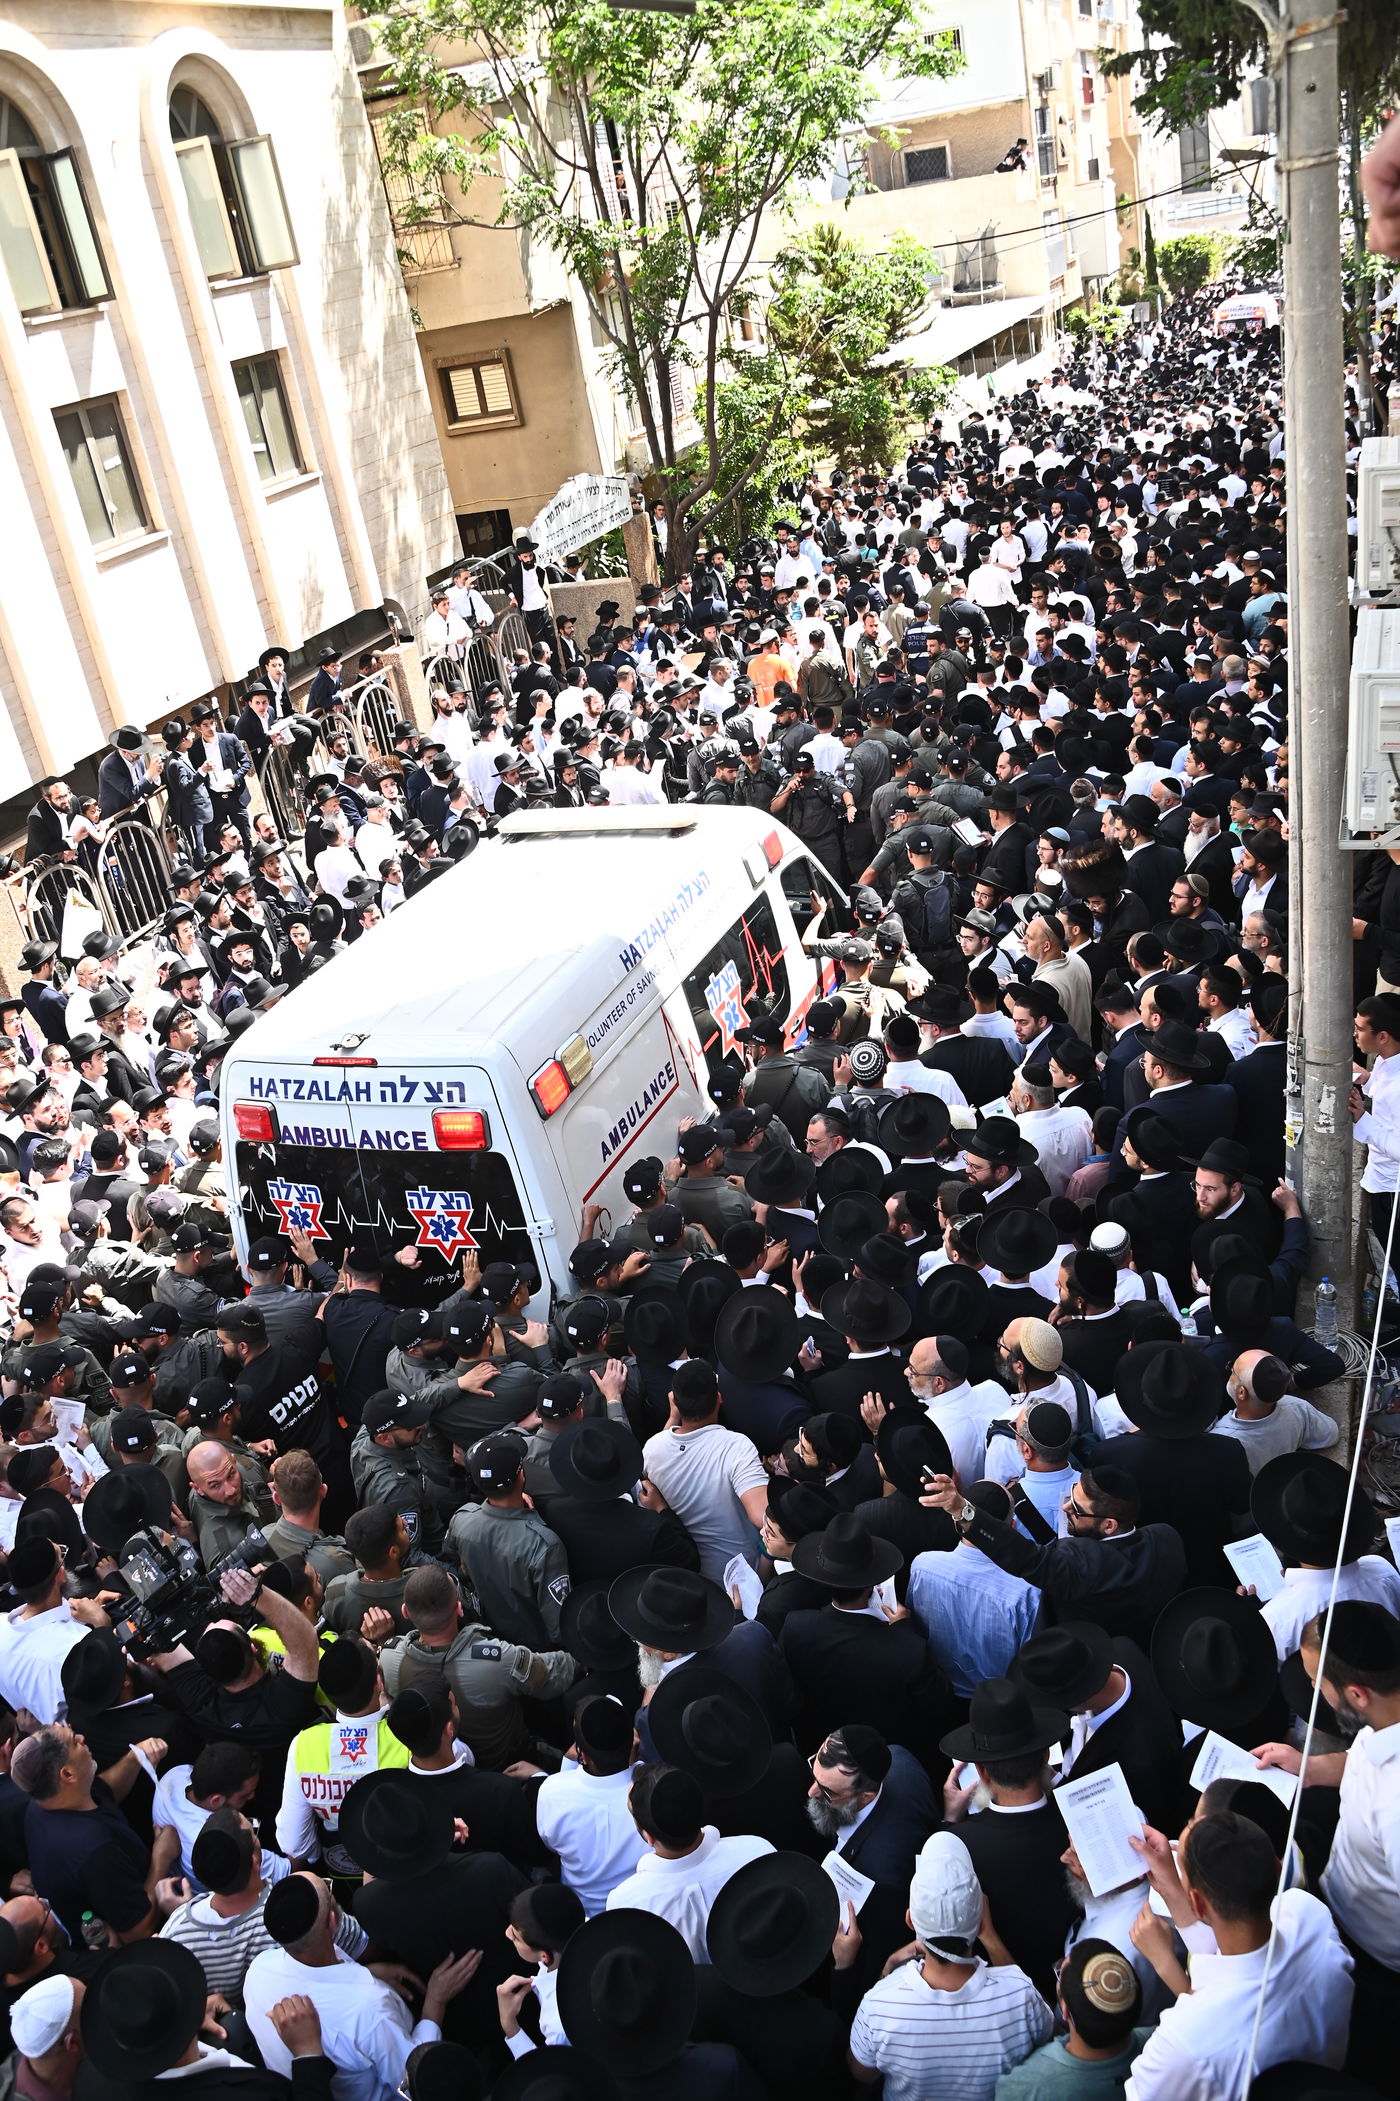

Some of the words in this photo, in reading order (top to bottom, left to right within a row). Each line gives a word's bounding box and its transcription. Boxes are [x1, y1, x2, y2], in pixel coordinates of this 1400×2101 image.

[619, 902, 681, 972] HATZALAH
[676, 870, 711, 913] הצלה
[626, 988, 637, 1005] OF
[706, 962, 739, 1011] הצלה
[250, 1076, 371, 1102] HATZALAH
[380, 1075, 466, 1103] הצלה
[601, 1061, 675, 1163] AMBULANCE
[281, 1125, 428, 1150] AMBULANCE
[268, 1178, 321, 1203] הצלה
[407, 1187, 471, 1210] הצלה
[218, 1398, 234, 1413] POLICE
[376, 1419, 395, 1433] POLICE
[340, 1726, 368, 1738] הצלה
[300, 1775, 356, 1800] מבולנס
